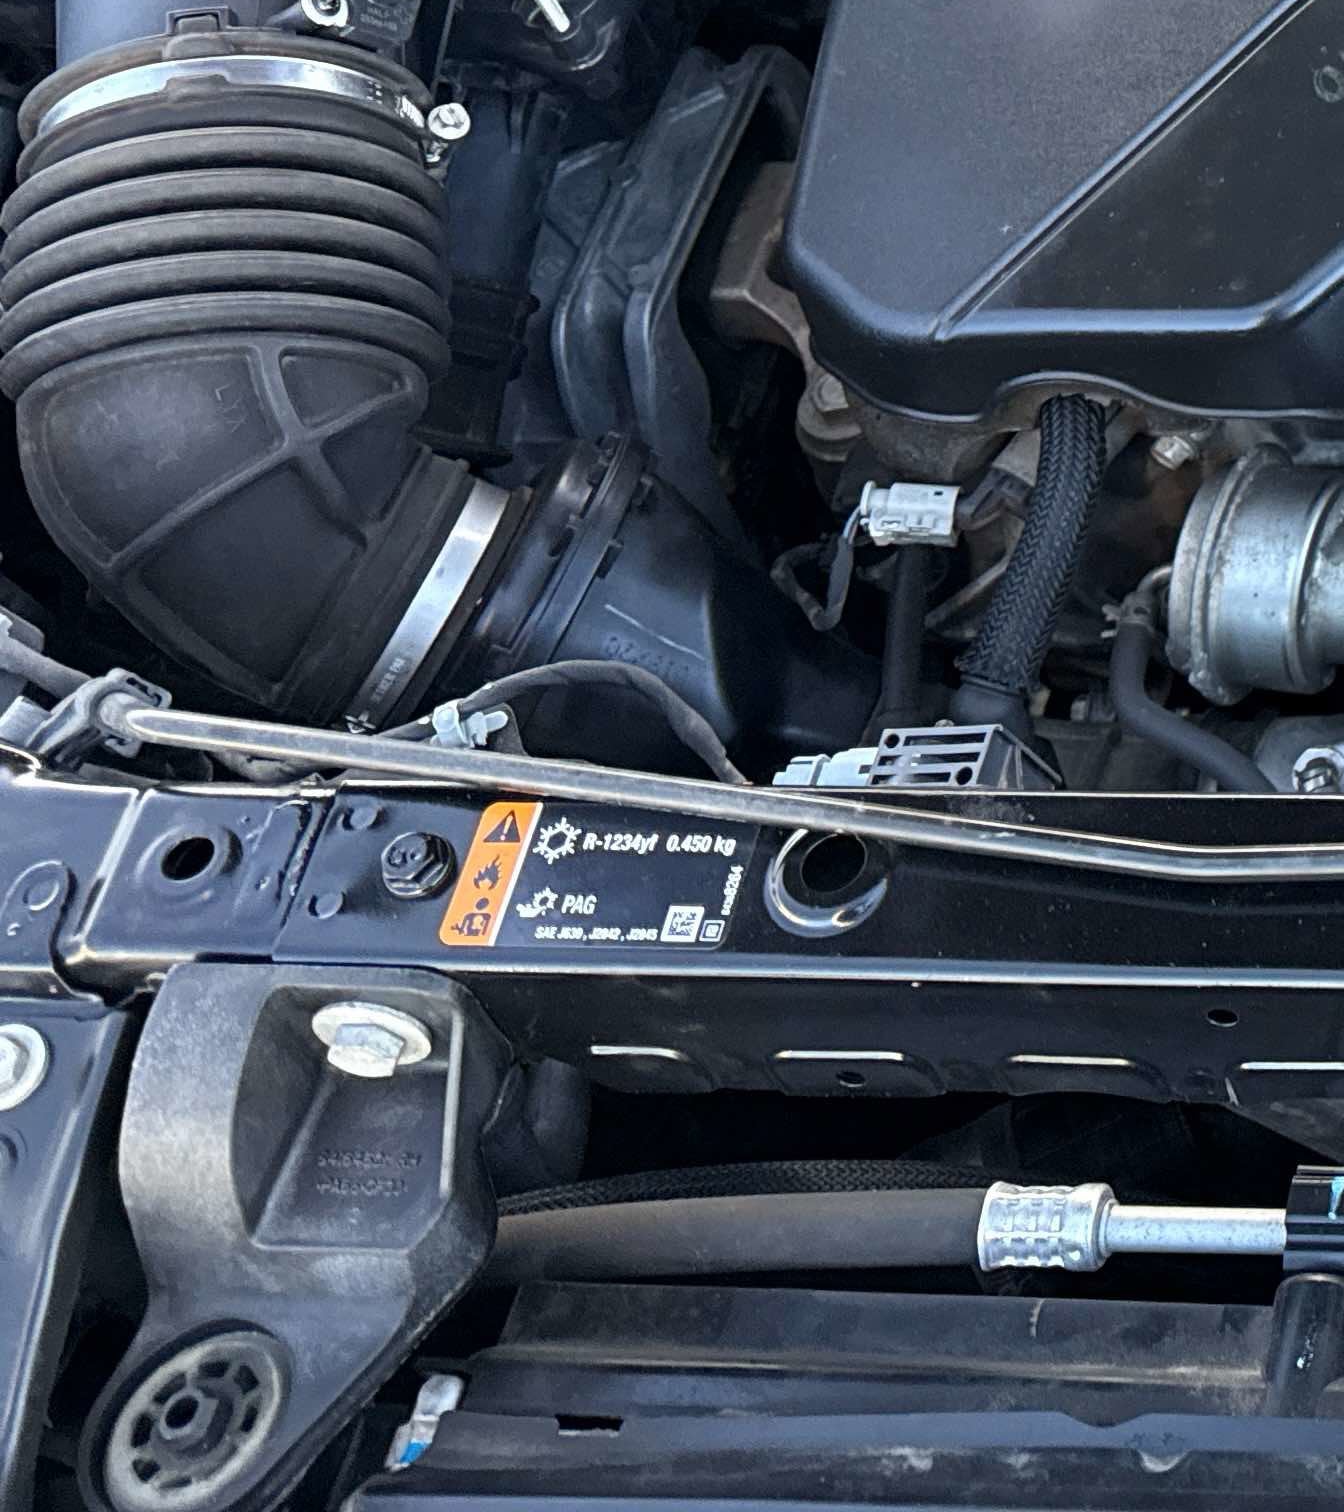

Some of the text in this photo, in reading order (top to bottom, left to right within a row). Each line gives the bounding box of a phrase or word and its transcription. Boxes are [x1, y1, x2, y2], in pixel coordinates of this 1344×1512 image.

[582, 832, 737, 857] R-1234yf 0.450 kg
[561, 894, 598, 915] PAG
